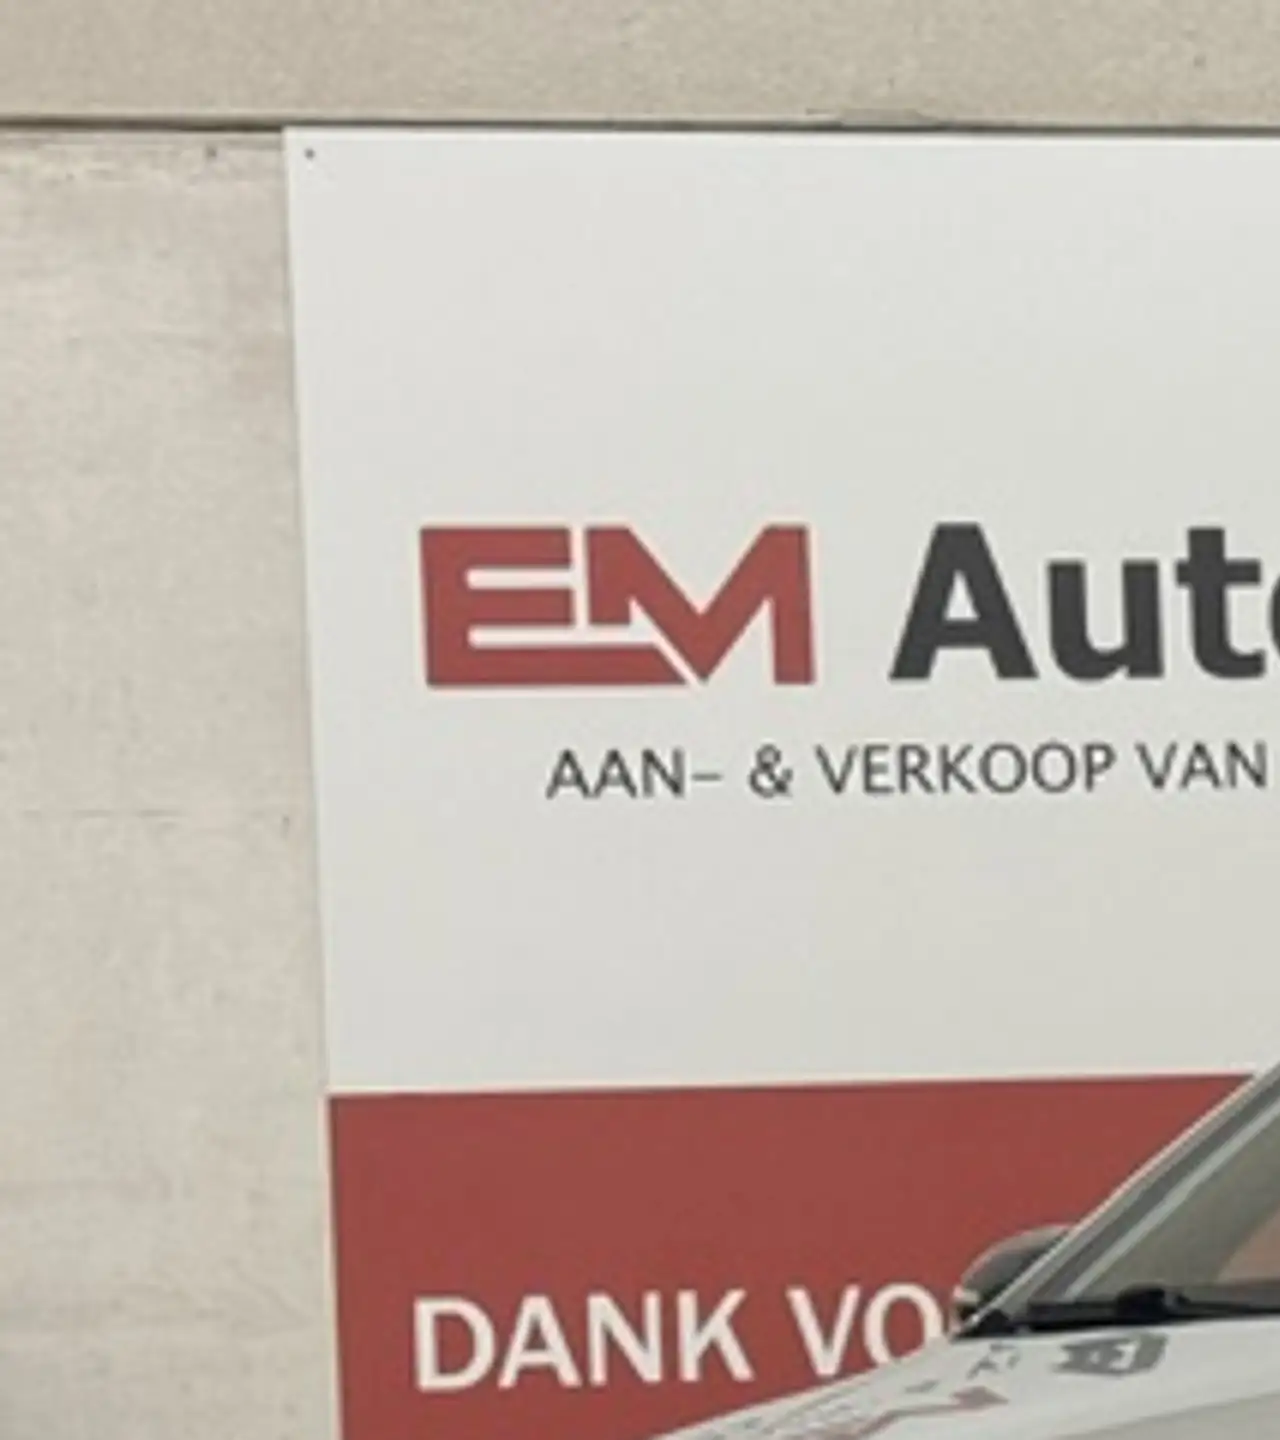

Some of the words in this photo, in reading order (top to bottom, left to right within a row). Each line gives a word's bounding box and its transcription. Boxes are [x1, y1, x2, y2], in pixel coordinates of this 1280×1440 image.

[420, 524, 817, 687] EM
[545, 746, 722, 799] AAN-
[748, 745, 794, 799] &
[815, 741, 1117, 796] VERKOOP
[1135, 739, 1268, 791] VAN
[412, 1288, 754, 1391] DANK
